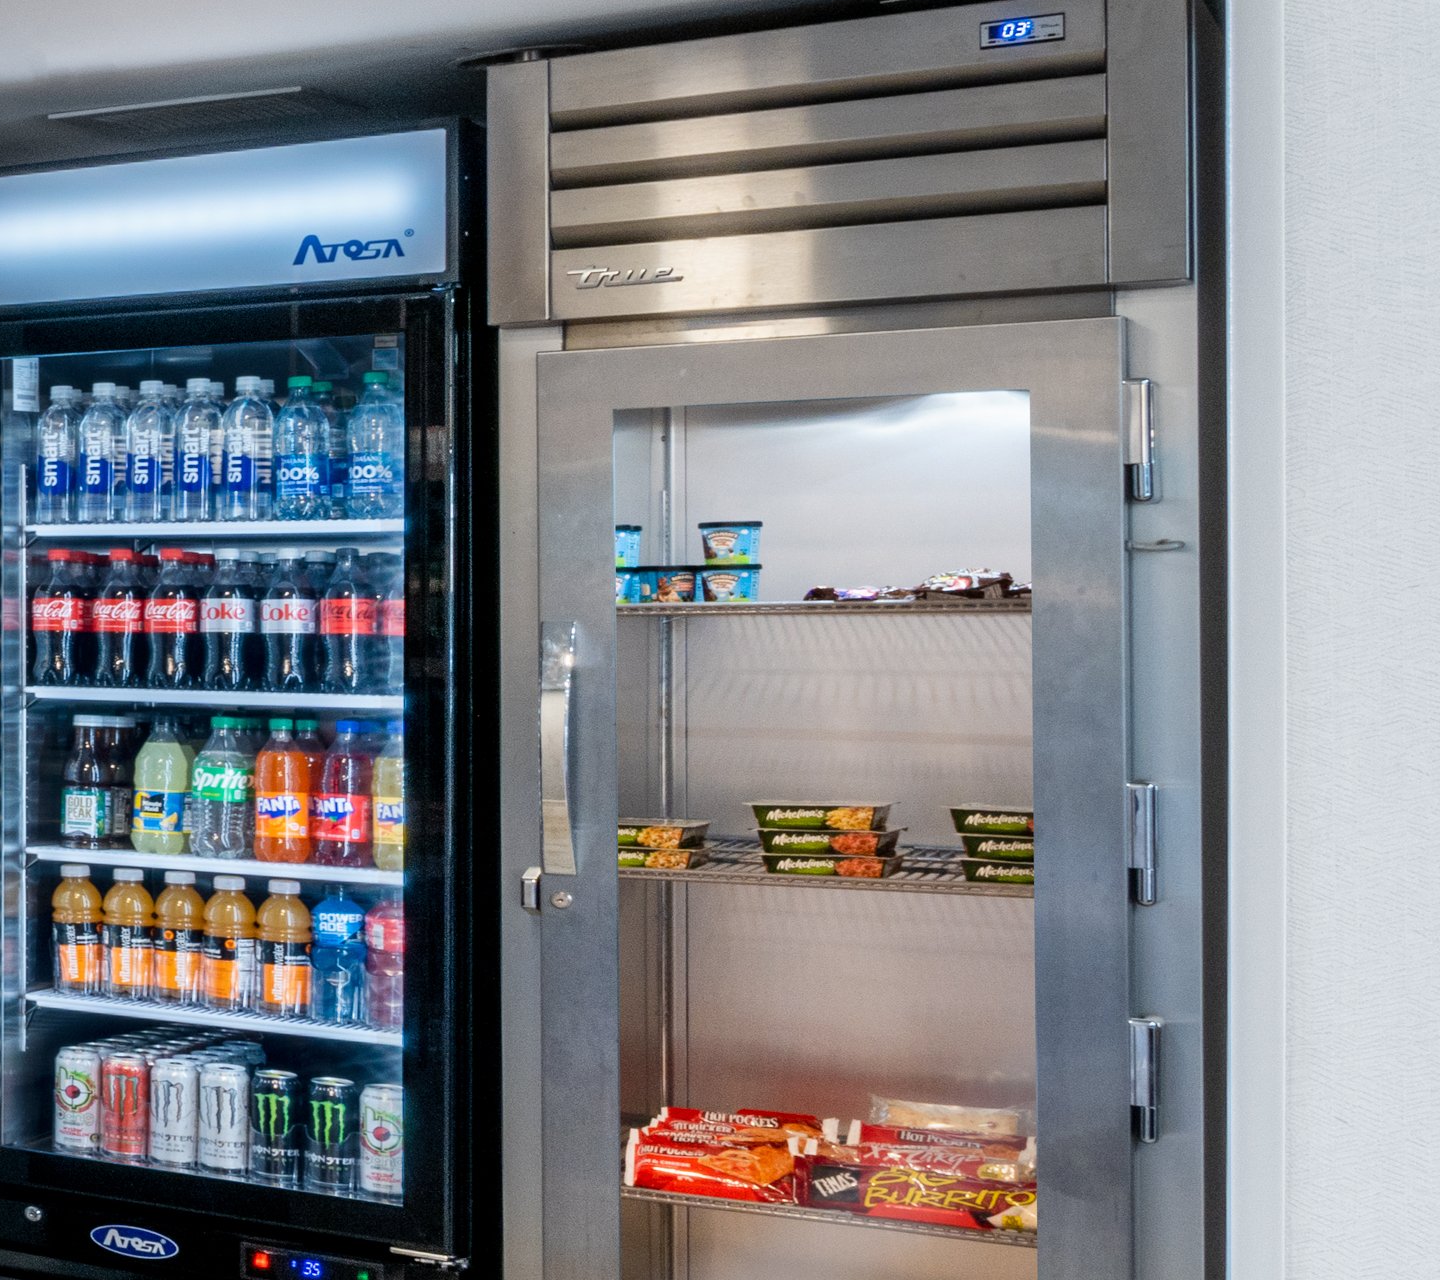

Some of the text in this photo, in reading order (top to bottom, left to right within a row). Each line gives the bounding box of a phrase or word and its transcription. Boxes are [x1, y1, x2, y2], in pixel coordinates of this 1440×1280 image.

[292, 234, 405, 266] ATOSA
[43, 431, 59, 487] smart
[86, 430, 102, 486] smart
[134, 428, 150, 485] smart
[183, 427, 199, 484] smart
[227, 426, 243, 483] smart
[144, 601, 196, 620] Coca-Cola
[200, 601, 246, 621] Coke
[260, 603, 310, 622] Coke
[192, 767, 247, 791] Sprite
[67, 796, 93, 808] GOLD
[256, 795, 301, 814] FANTA
[376, 803, 404, 819] FAN
[67, 807, 93, 819] PEAK
[766, 808, 824, 821] Michelina's
[965, 813, 1028, 826] Michelina's
[772, 832, 830, 846] Michelina's
[977, 840, 1034, 853] Michelina
[776, 857, 834, 871] Michelina's
[319, 922, 347, 932] ADE
[704, 1110, 779, 1128] HOT POCKETS
[899, 1129, 981, 1149] HOT POCKETS
[812, 1172, 858, 1198] TINA'S
[864, 1186, 1037, 1210] BURRITO
[102, 1228, 167, 1256] ATOSA
